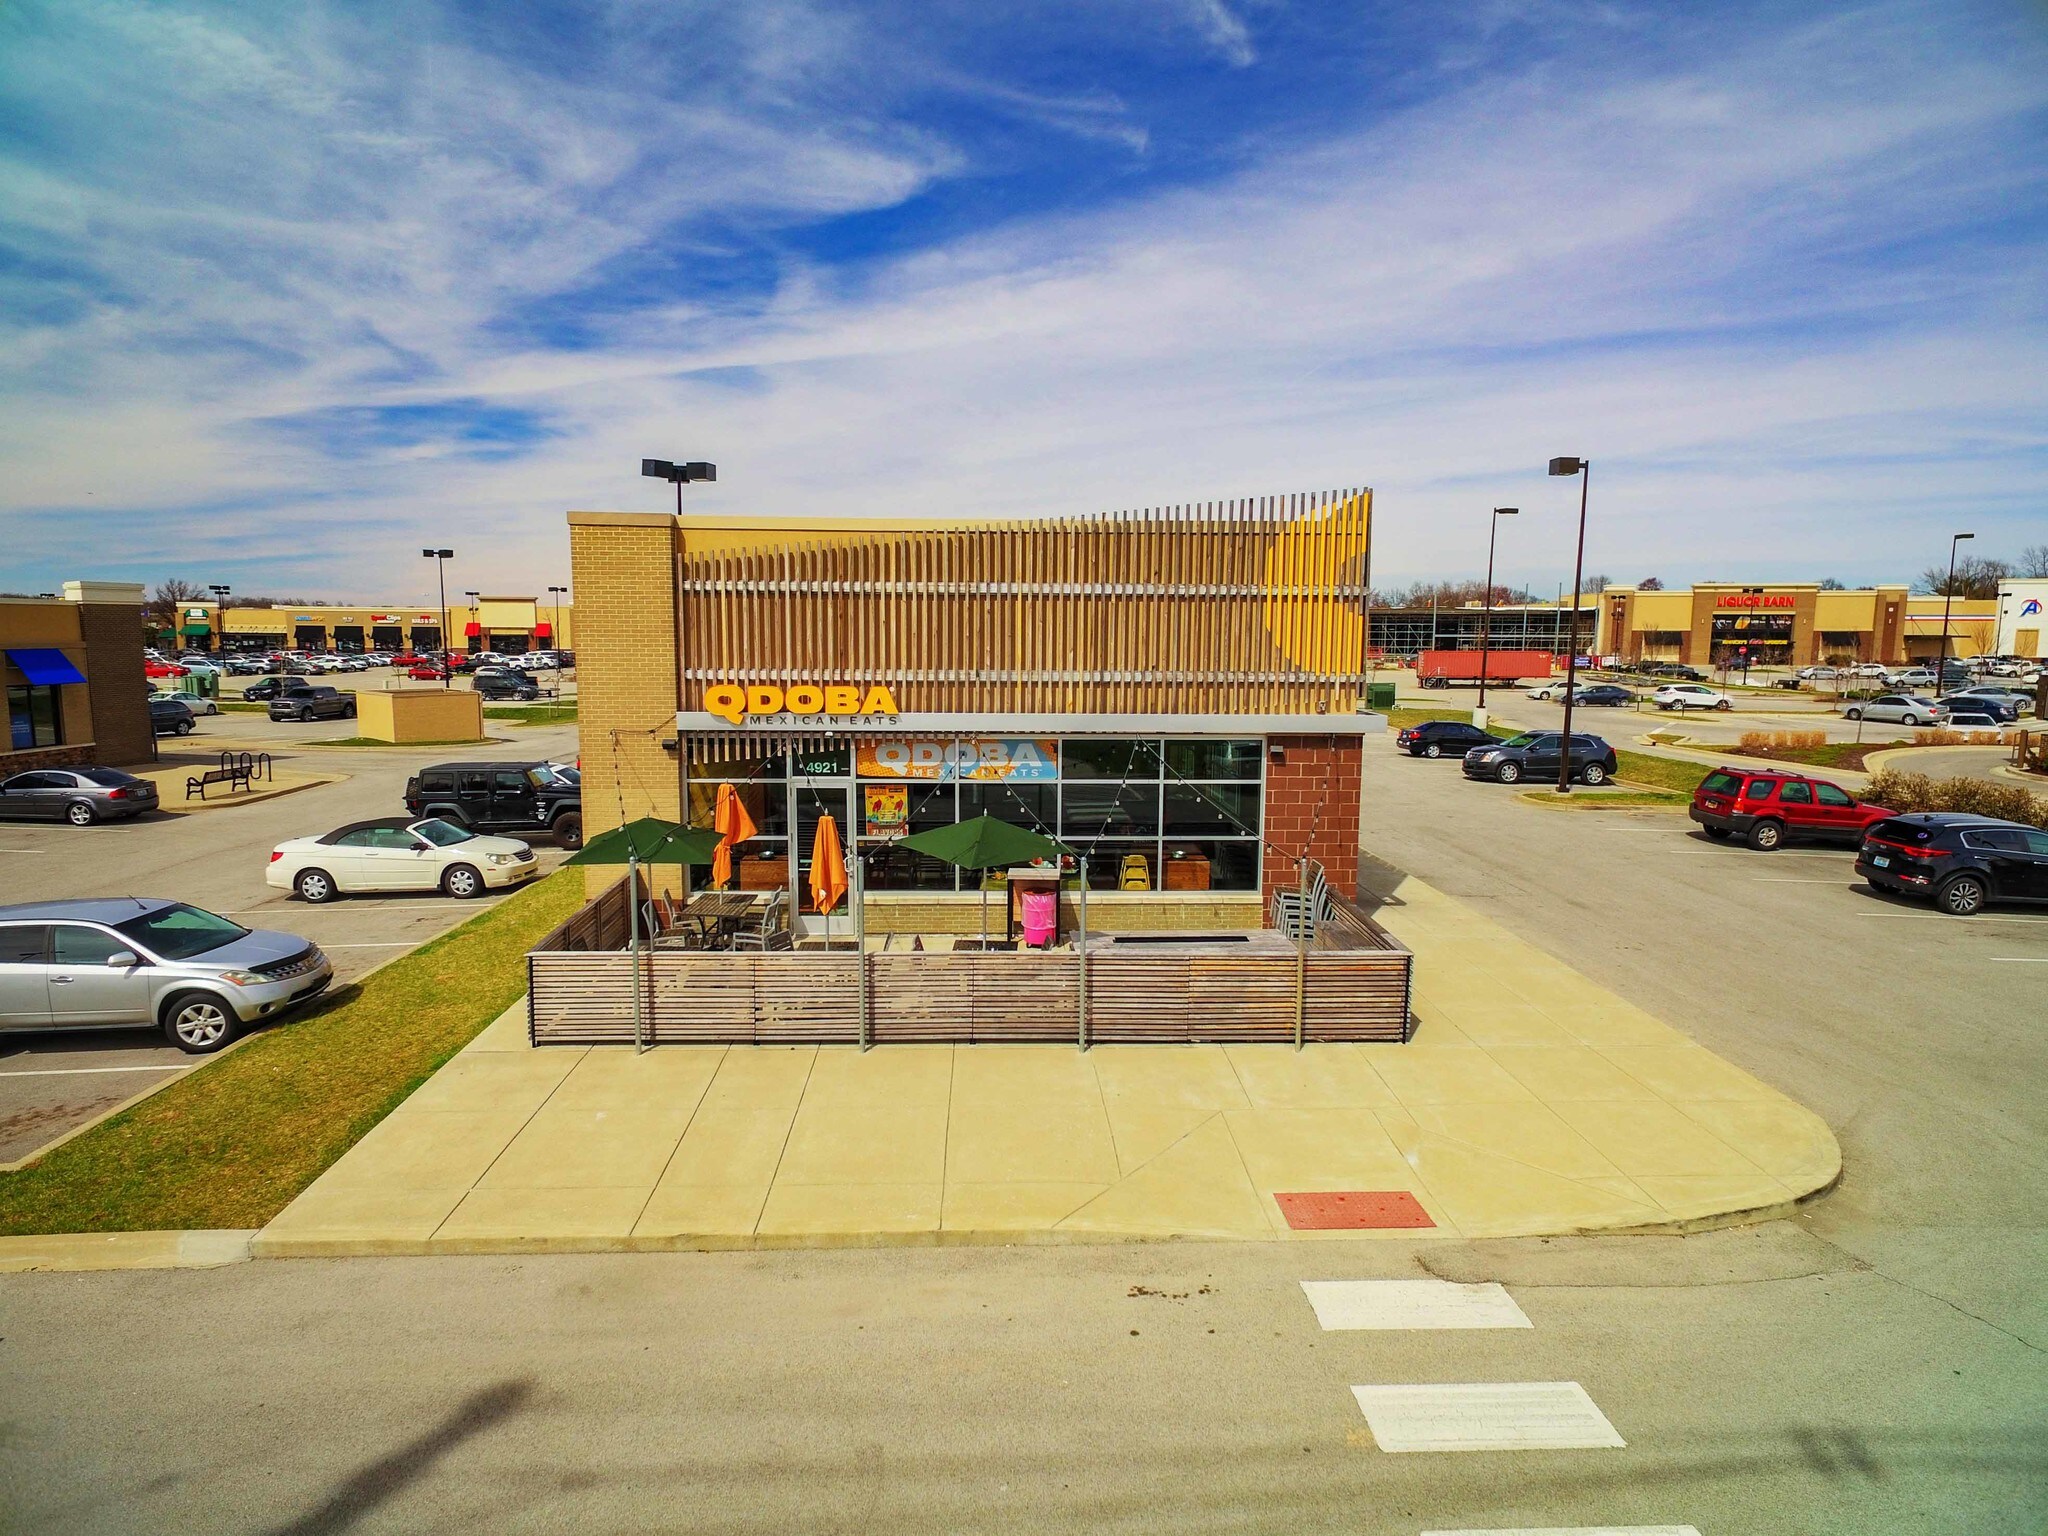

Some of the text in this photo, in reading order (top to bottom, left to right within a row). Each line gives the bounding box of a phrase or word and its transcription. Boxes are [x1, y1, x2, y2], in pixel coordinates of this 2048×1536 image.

[1716, 596, 1796, 607] LIQUOR BARN
[704, 684, 899, 725] QDOBA
[750, 716, 898, 725] MEXICAN EATS
[876, 743, 1042, 777] QDOBA
[806, 762, 838, 774] 4921
[998, 768, 1040, 777] EATS
